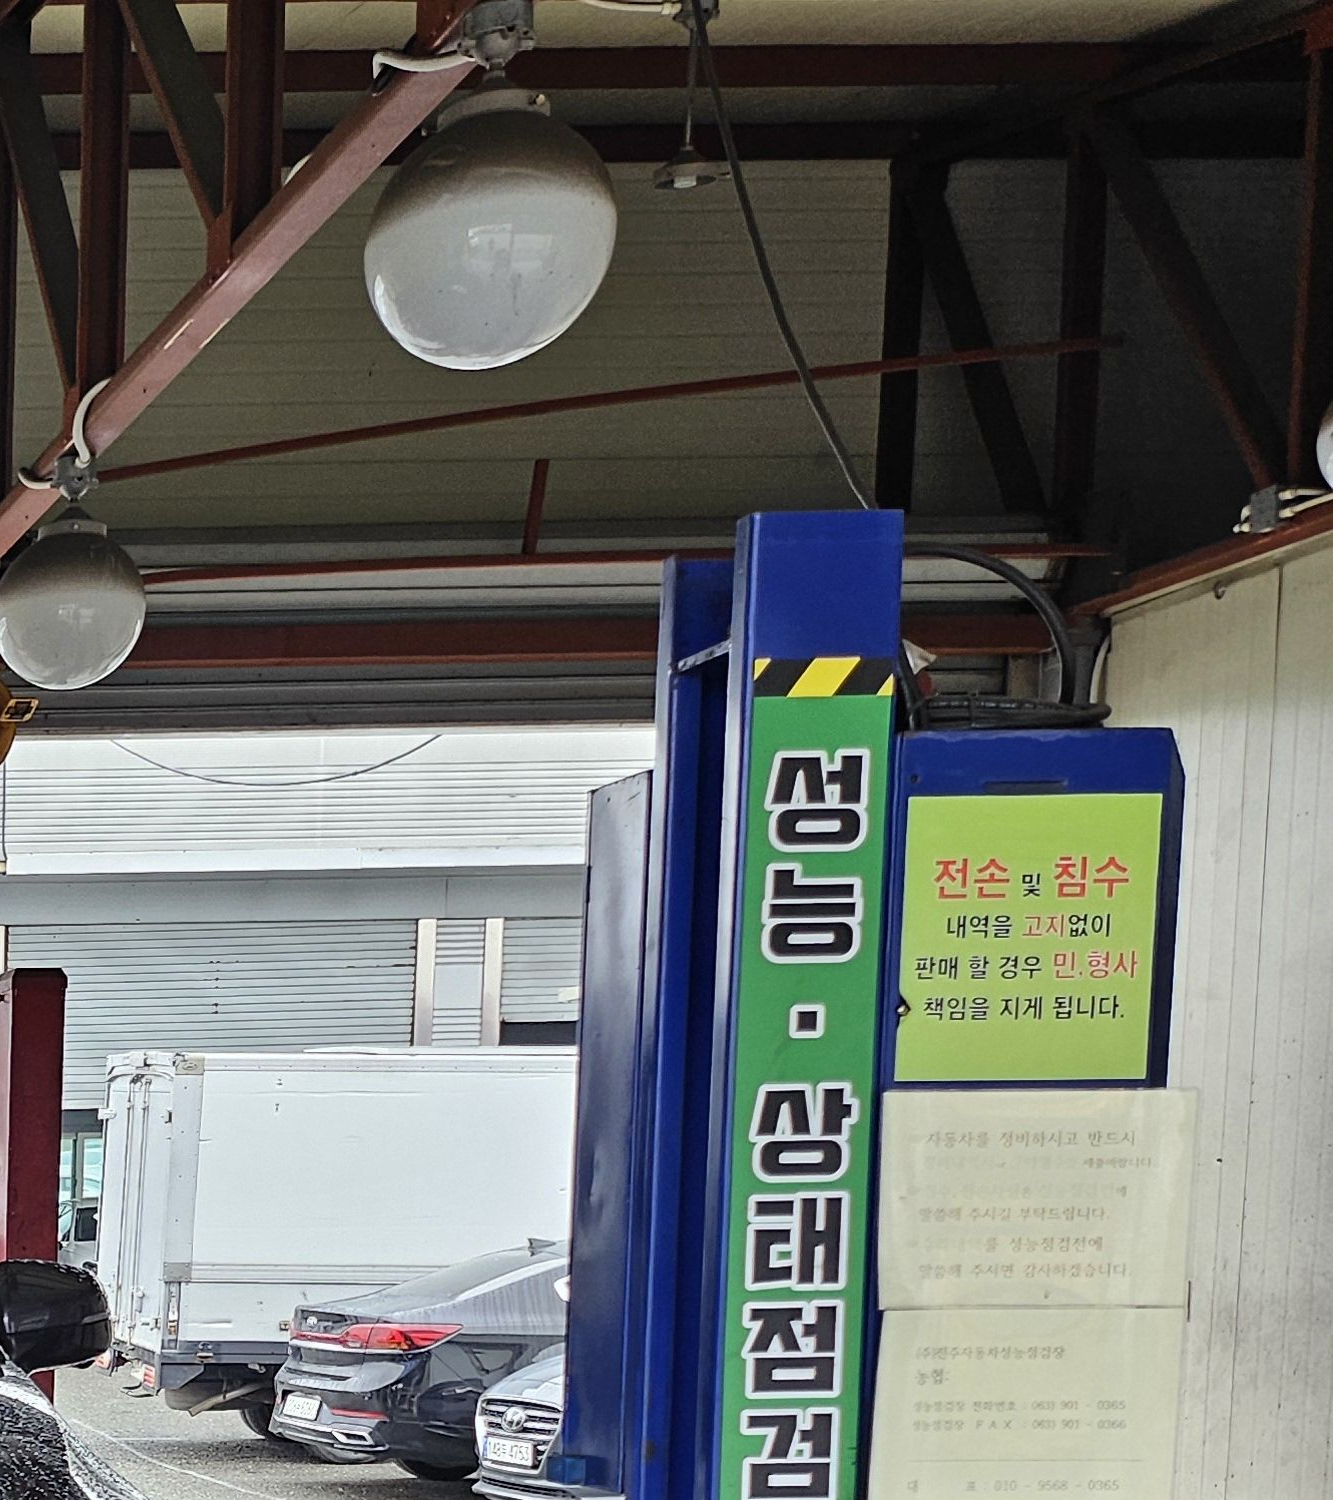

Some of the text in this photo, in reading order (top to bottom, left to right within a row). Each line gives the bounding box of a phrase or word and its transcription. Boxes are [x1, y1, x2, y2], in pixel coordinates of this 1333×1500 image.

[933, 855, 1130, 899] 전손 및 침수
[946, 912, 1112, 939] 내역을 고지없이
[914, 949, 1138, 981] 판매 할 경우 민.형사
[922, 994, 1125, 1021] 책임을 지게 됩니다.
[1088, 1130, 1135, 1148] 반드시
